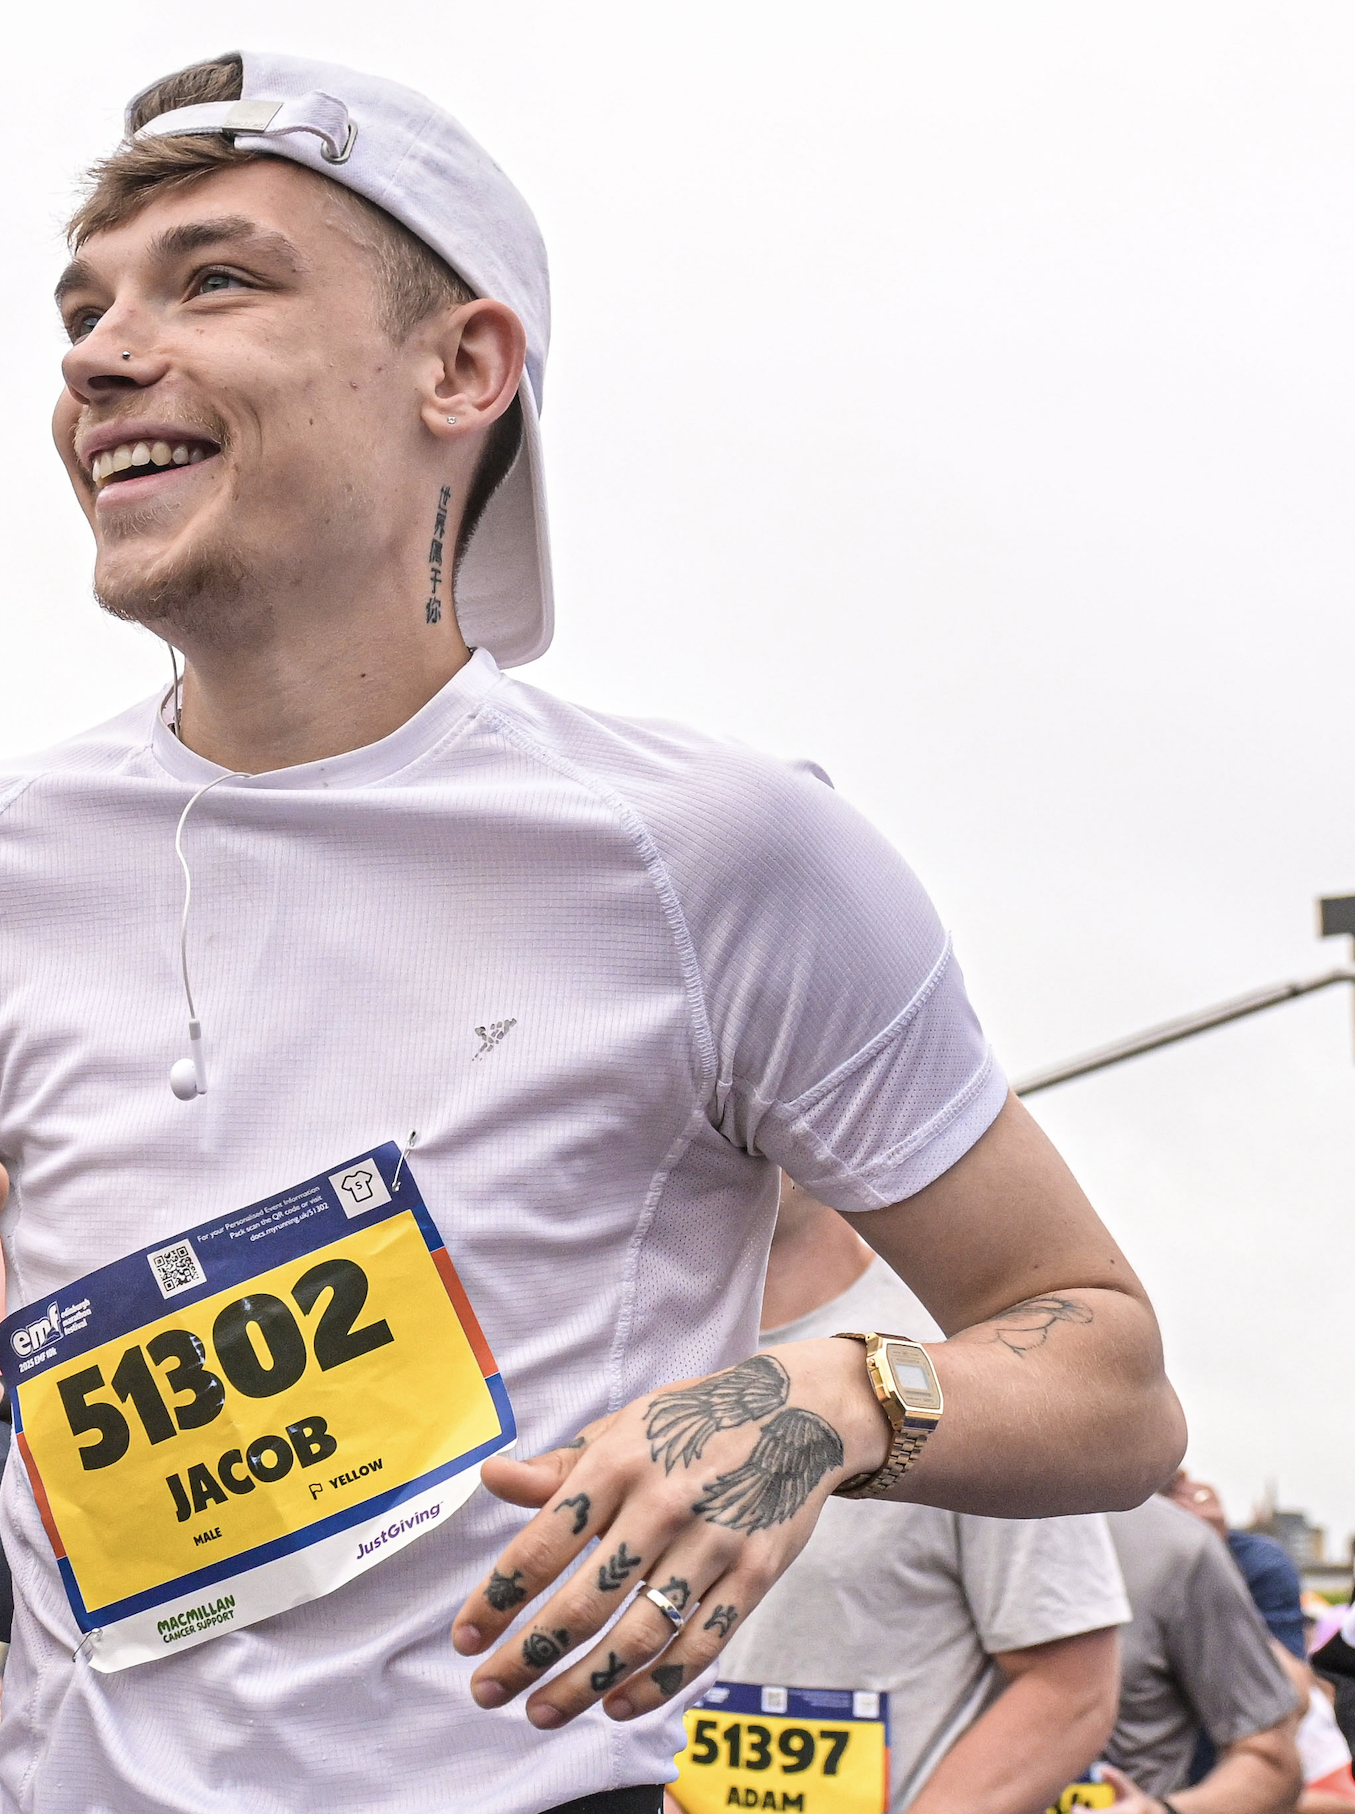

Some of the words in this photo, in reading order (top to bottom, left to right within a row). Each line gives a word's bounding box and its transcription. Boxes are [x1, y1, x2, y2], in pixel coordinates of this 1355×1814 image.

[355, 1181, 363, 1191] S
[197, 1233, 209, 1243] For
[210, 1227, 224, 1239] your
[225, 1209, 264, 1231] Personalised
[264, 1202, 283, 1214] Event
[283, 1187, 320, 1206] Information
[229, 1228, 246, 1240] Pack
[246, 1222, 260, 1233] scan
[260, 1217, 272, 1226] the
[272, 1211, 285, 1221] QR
[285, 1205, 301, 1216] code
[301, 1201, 309, 1209] or
[250, 1202, 330, 1242] docs.myrunning.uk/51302
[10, 1301, 63, 1358] emf
[56, 1258, 395, 1471] 51302
[165, 1416, 338, 1523] JACOB
[329, 1458, 383, 1489] YELLOW
[193, 1526, 222, 1547] MALE
[356, 1502, 441, 1560] JustGiving
[157, 1594, 236, 1635] MACMILLAN
[163, 1626, 196, 1643] CANCER
[196, 1609, 234, 1631] SUPPORT
[692, 1719, 850, 1776] 51397
[726, 1786, 805, 1813] ADAM
